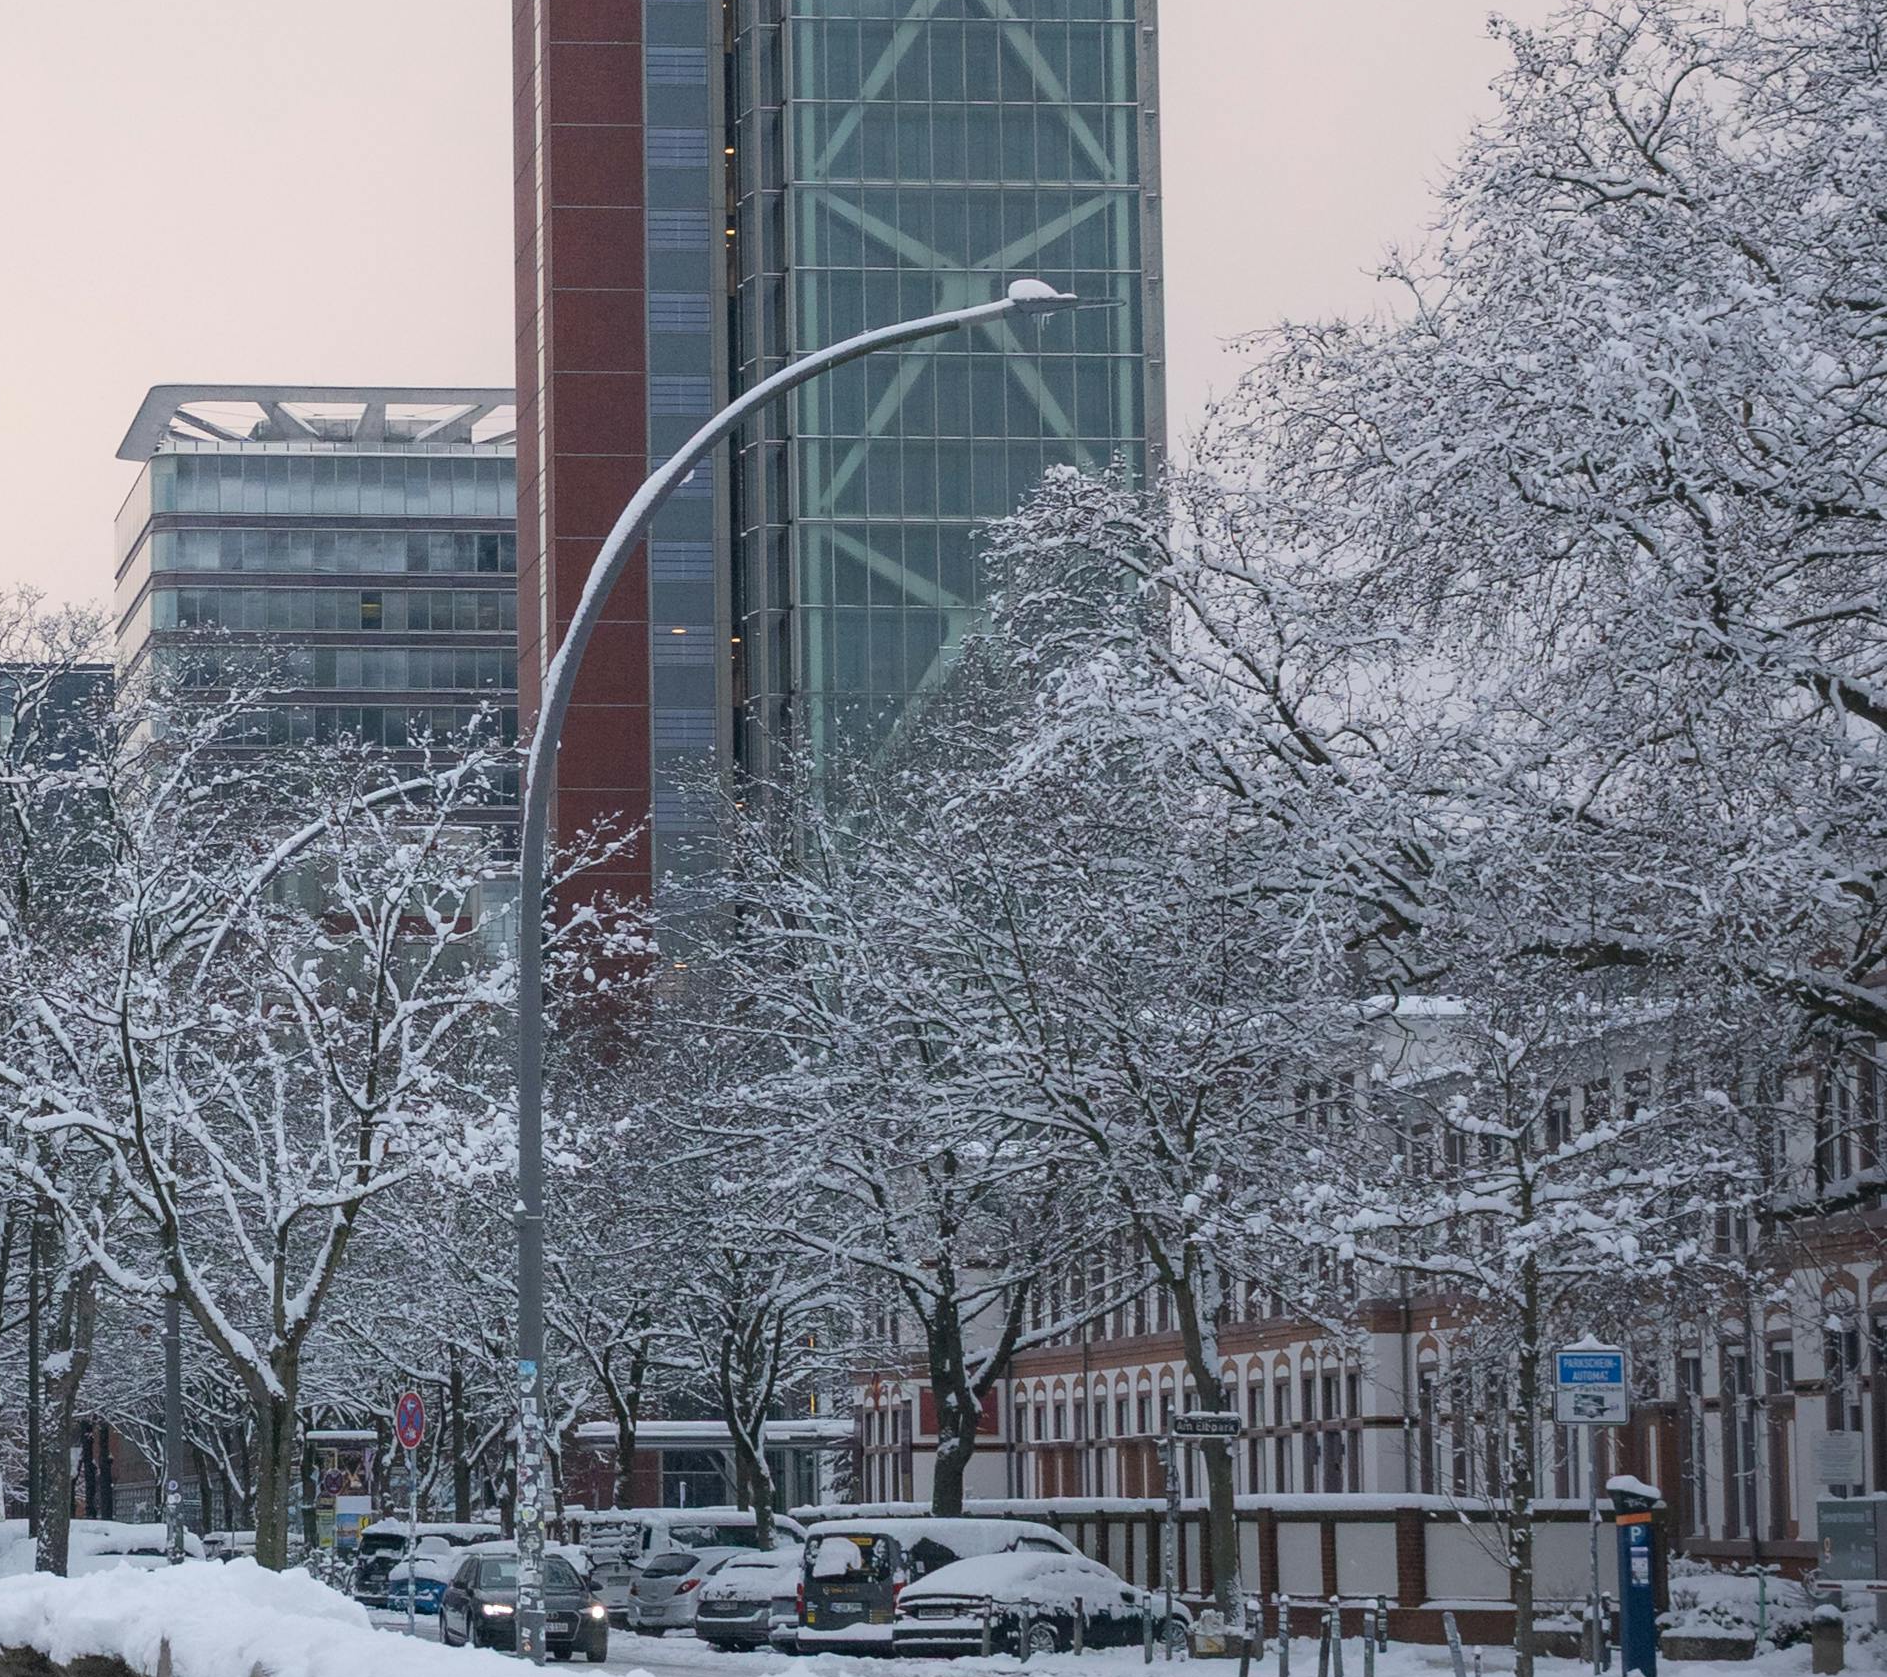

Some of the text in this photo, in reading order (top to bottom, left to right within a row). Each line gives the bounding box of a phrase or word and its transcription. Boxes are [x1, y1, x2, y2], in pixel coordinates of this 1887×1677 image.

[1563, 1358, 1618, 1368] PARKSCHEIN-
[1176, 1421, 1193, 1431] Am
[1630, 1526, 1642, 1543] P
